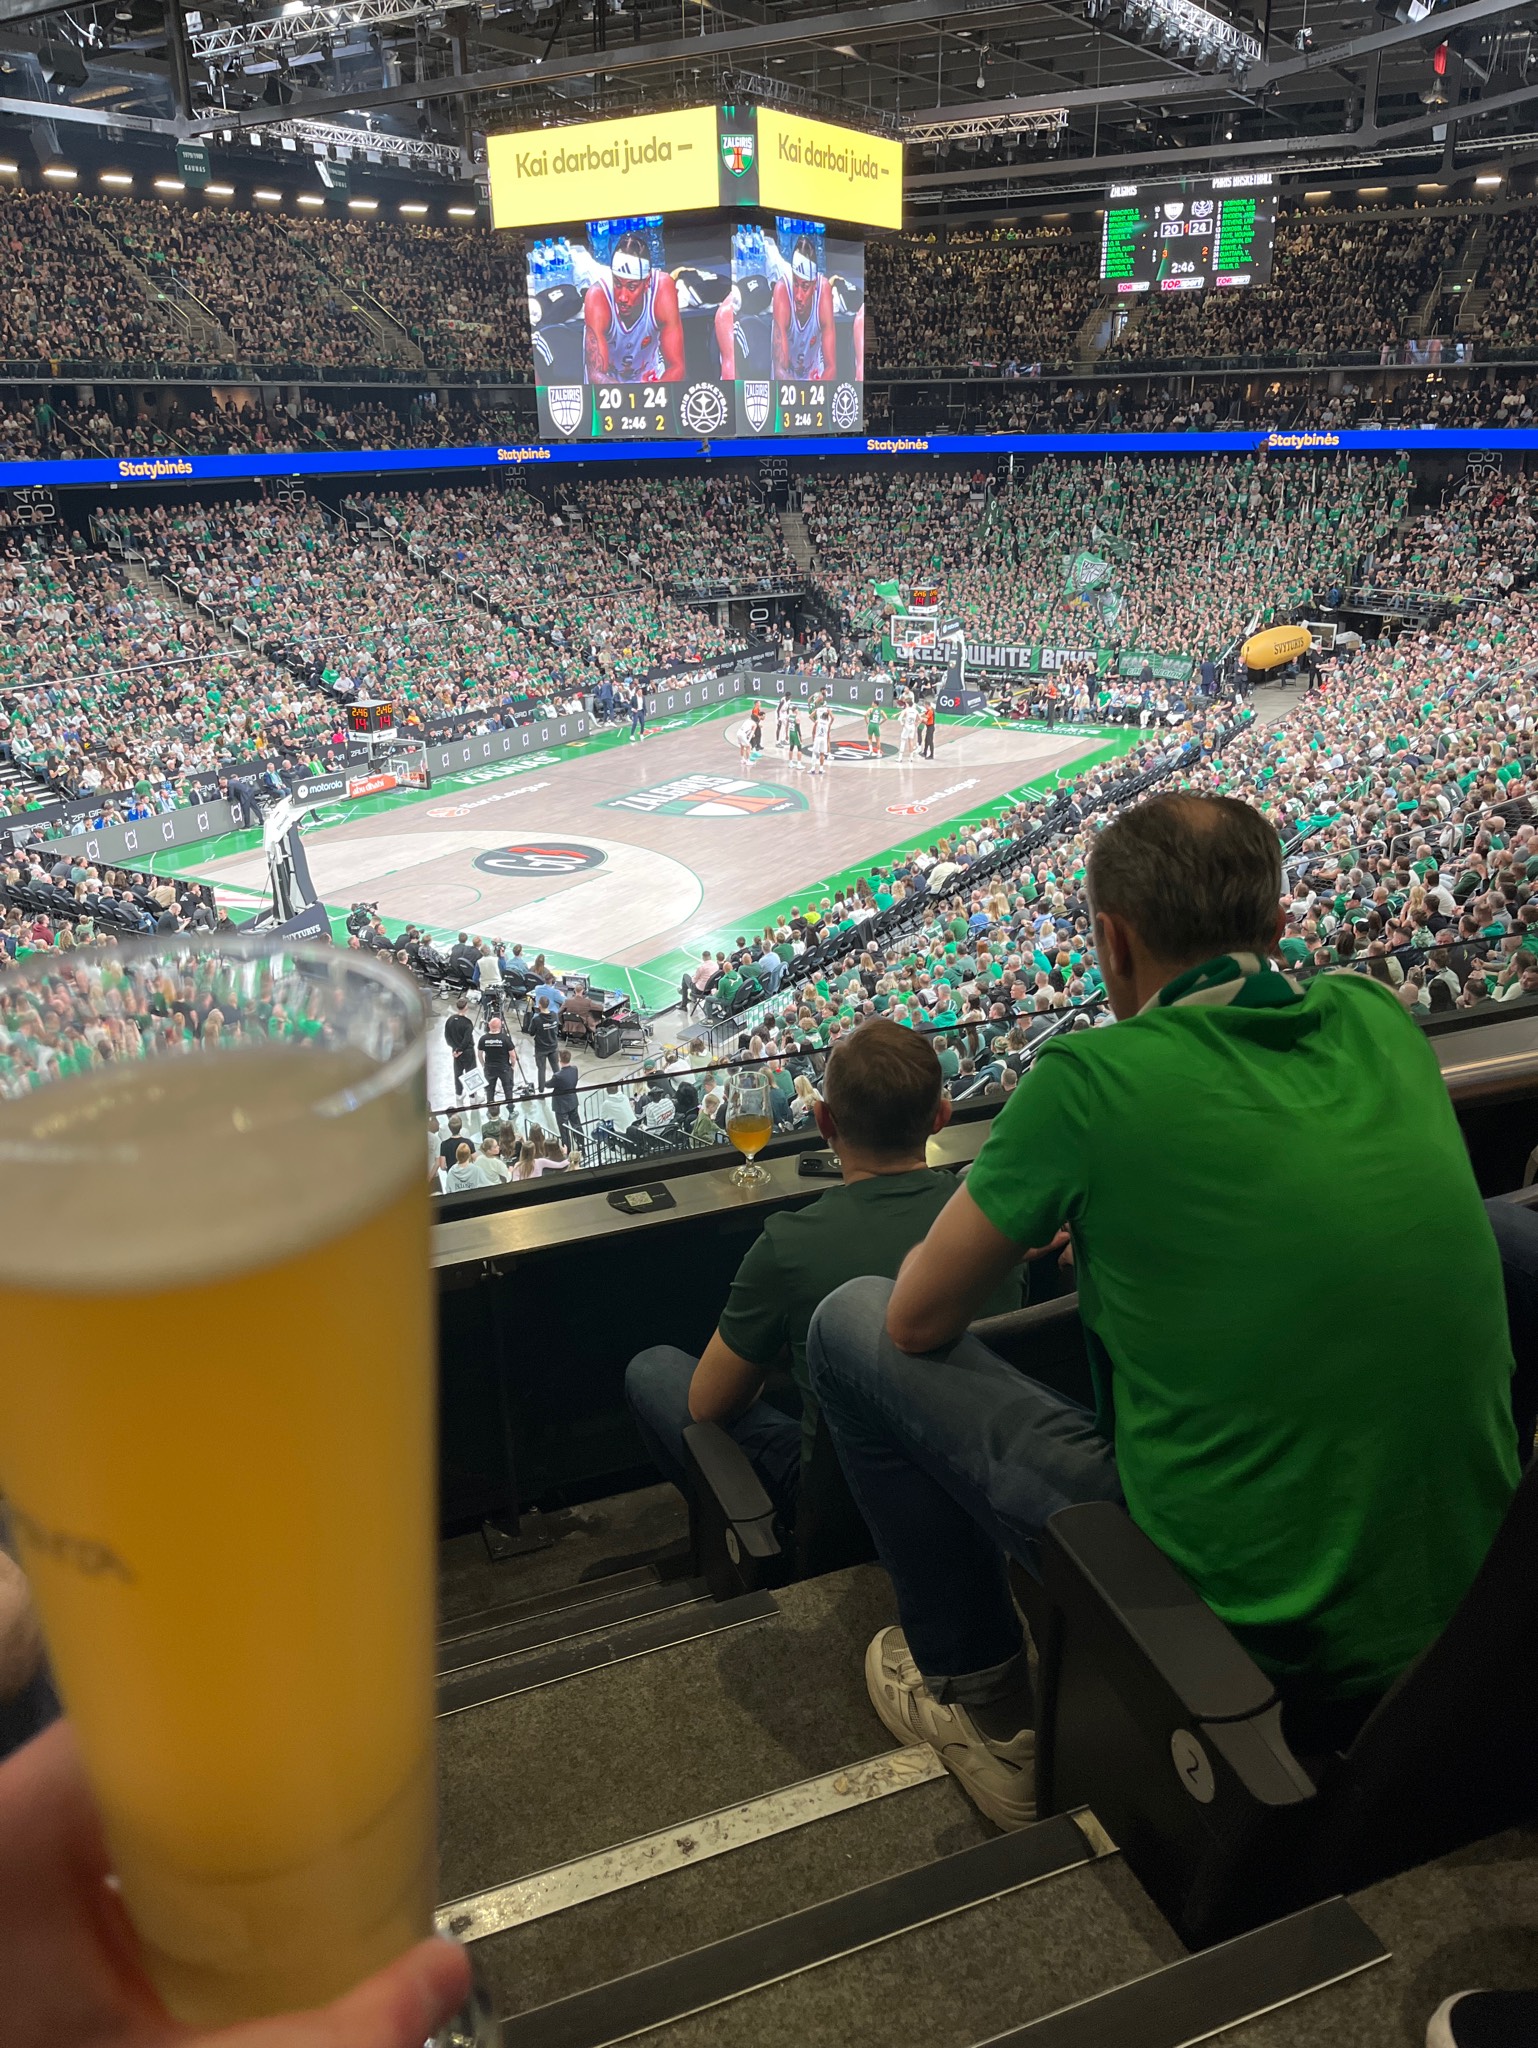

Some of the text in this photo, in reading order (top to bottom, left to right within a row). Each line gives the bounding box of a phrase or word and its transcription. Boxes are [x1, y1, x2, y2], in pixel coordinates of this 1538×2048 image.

[516, 150, 548, 178] Kai
[552, 144, 620, 174] darbai
[621, 136, 672, 174] juda
[778, 133, 802, 164] Kai
[804, 141, 848, 173] darbai
[848, 150, 878, 182] juda
[1164, 223, 1206, 234] 20 1 24
[1162, 249, 1168, 258] 3
[1202, 246, 1208, 255] 2
[1171, 262, 1195, 273] 2:46
[600, 386, 667, 409] 20 1 24
[781, 385, 825, 405] 20 1 24
[680, 382, 728, 427] PARIS BASKETBALL
[604, 415, 665, 431] 3 2:46 2
[784, 412, 823, 428] 3 2:46 2
[867, 438, 929, 454] Statybinės
[1268, 433, 1340, 449] Statybinės
[497, 448, 551, 463] Statybinės
[119, 459, 192, 480] Statybinės
[968, 645, 1031, 668] WHITE
[940, 696, 960, 707] Go3
[351, 707, 369, 717] 2:46
[376, 704, 392, 716] 2:46
[355, 718, 367, 730] 14
[379, 715, 391, 728] 14
[310, 780, 343, 794] motorola
